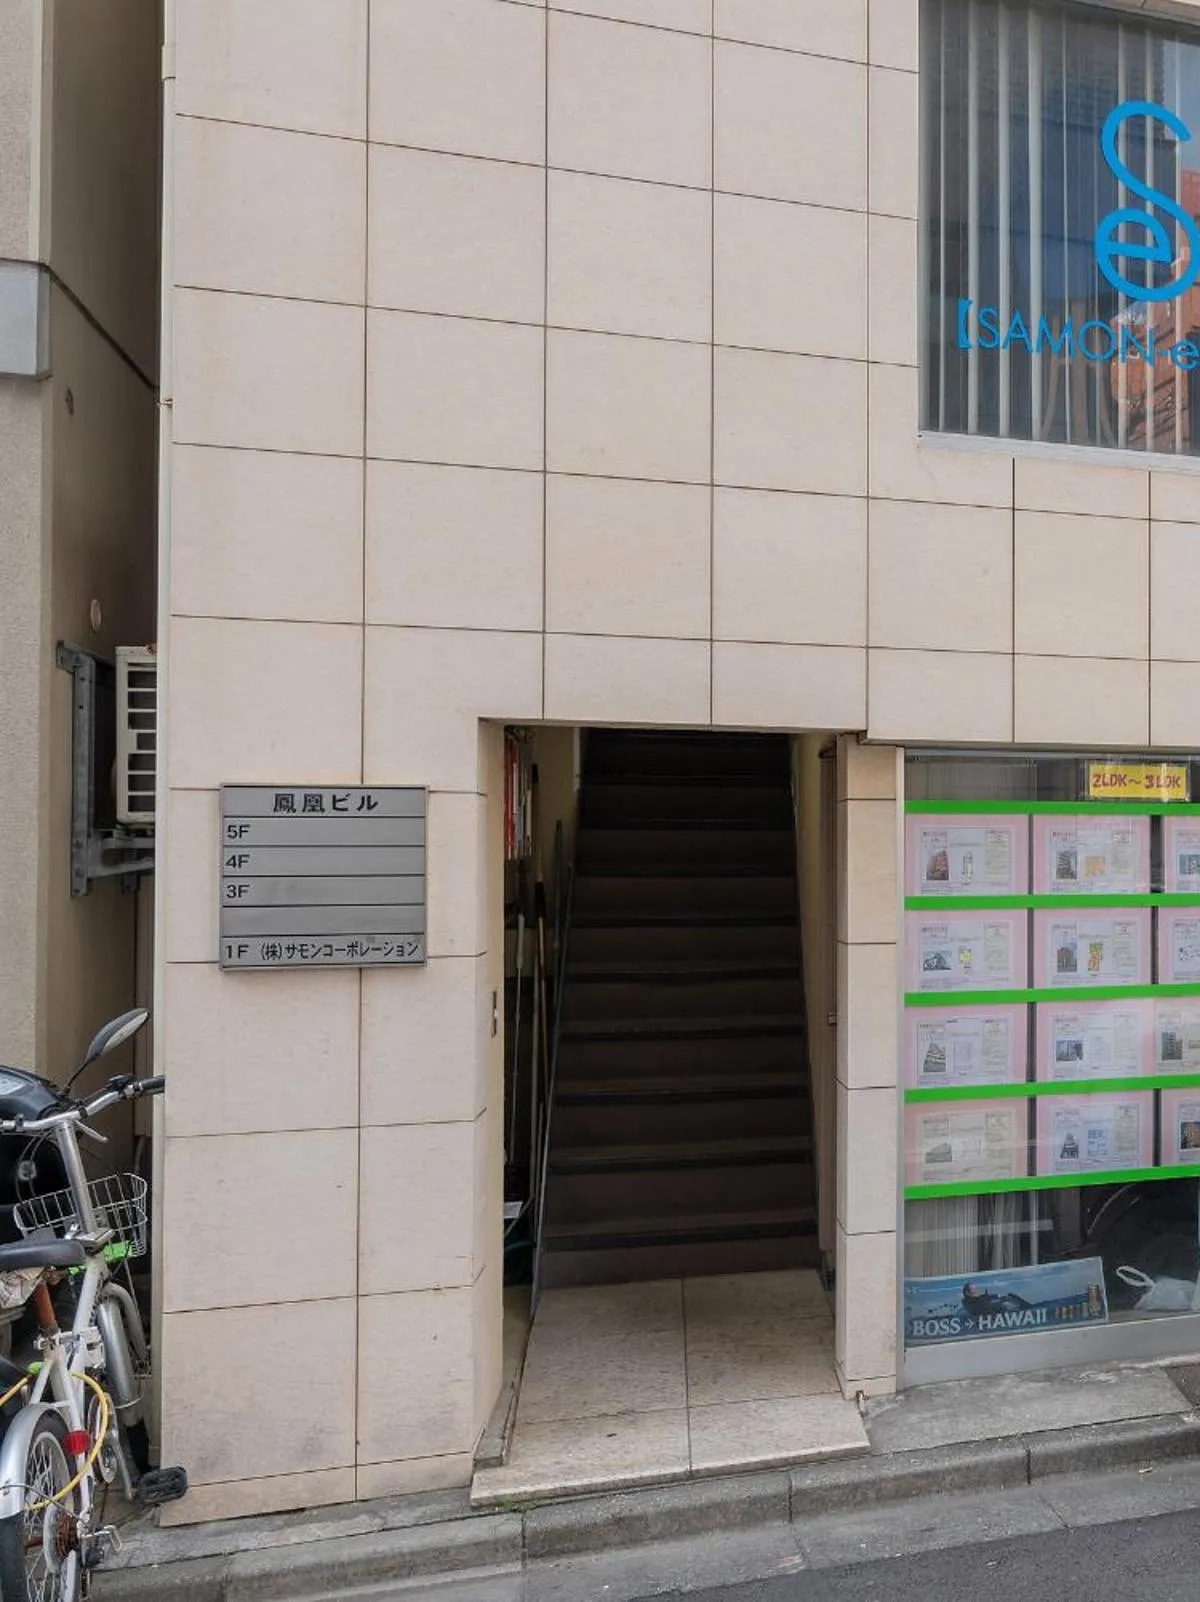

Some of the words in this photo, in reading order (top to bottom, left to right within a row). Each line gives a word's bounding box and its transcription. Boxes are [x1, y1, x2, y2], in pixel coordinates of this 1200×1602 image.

[272, 793, 379, 813] 鳳凰ビル
[227, 824, 250, 839] 5F
[225, 854, 250, 869] 4F
[226, 885, 250, 899] 3F
[225, 945, 249, 960] 1F
[912, 1317, 961, 1336] BOSS
[978, 1308, 1046, 1330] HAWAII
